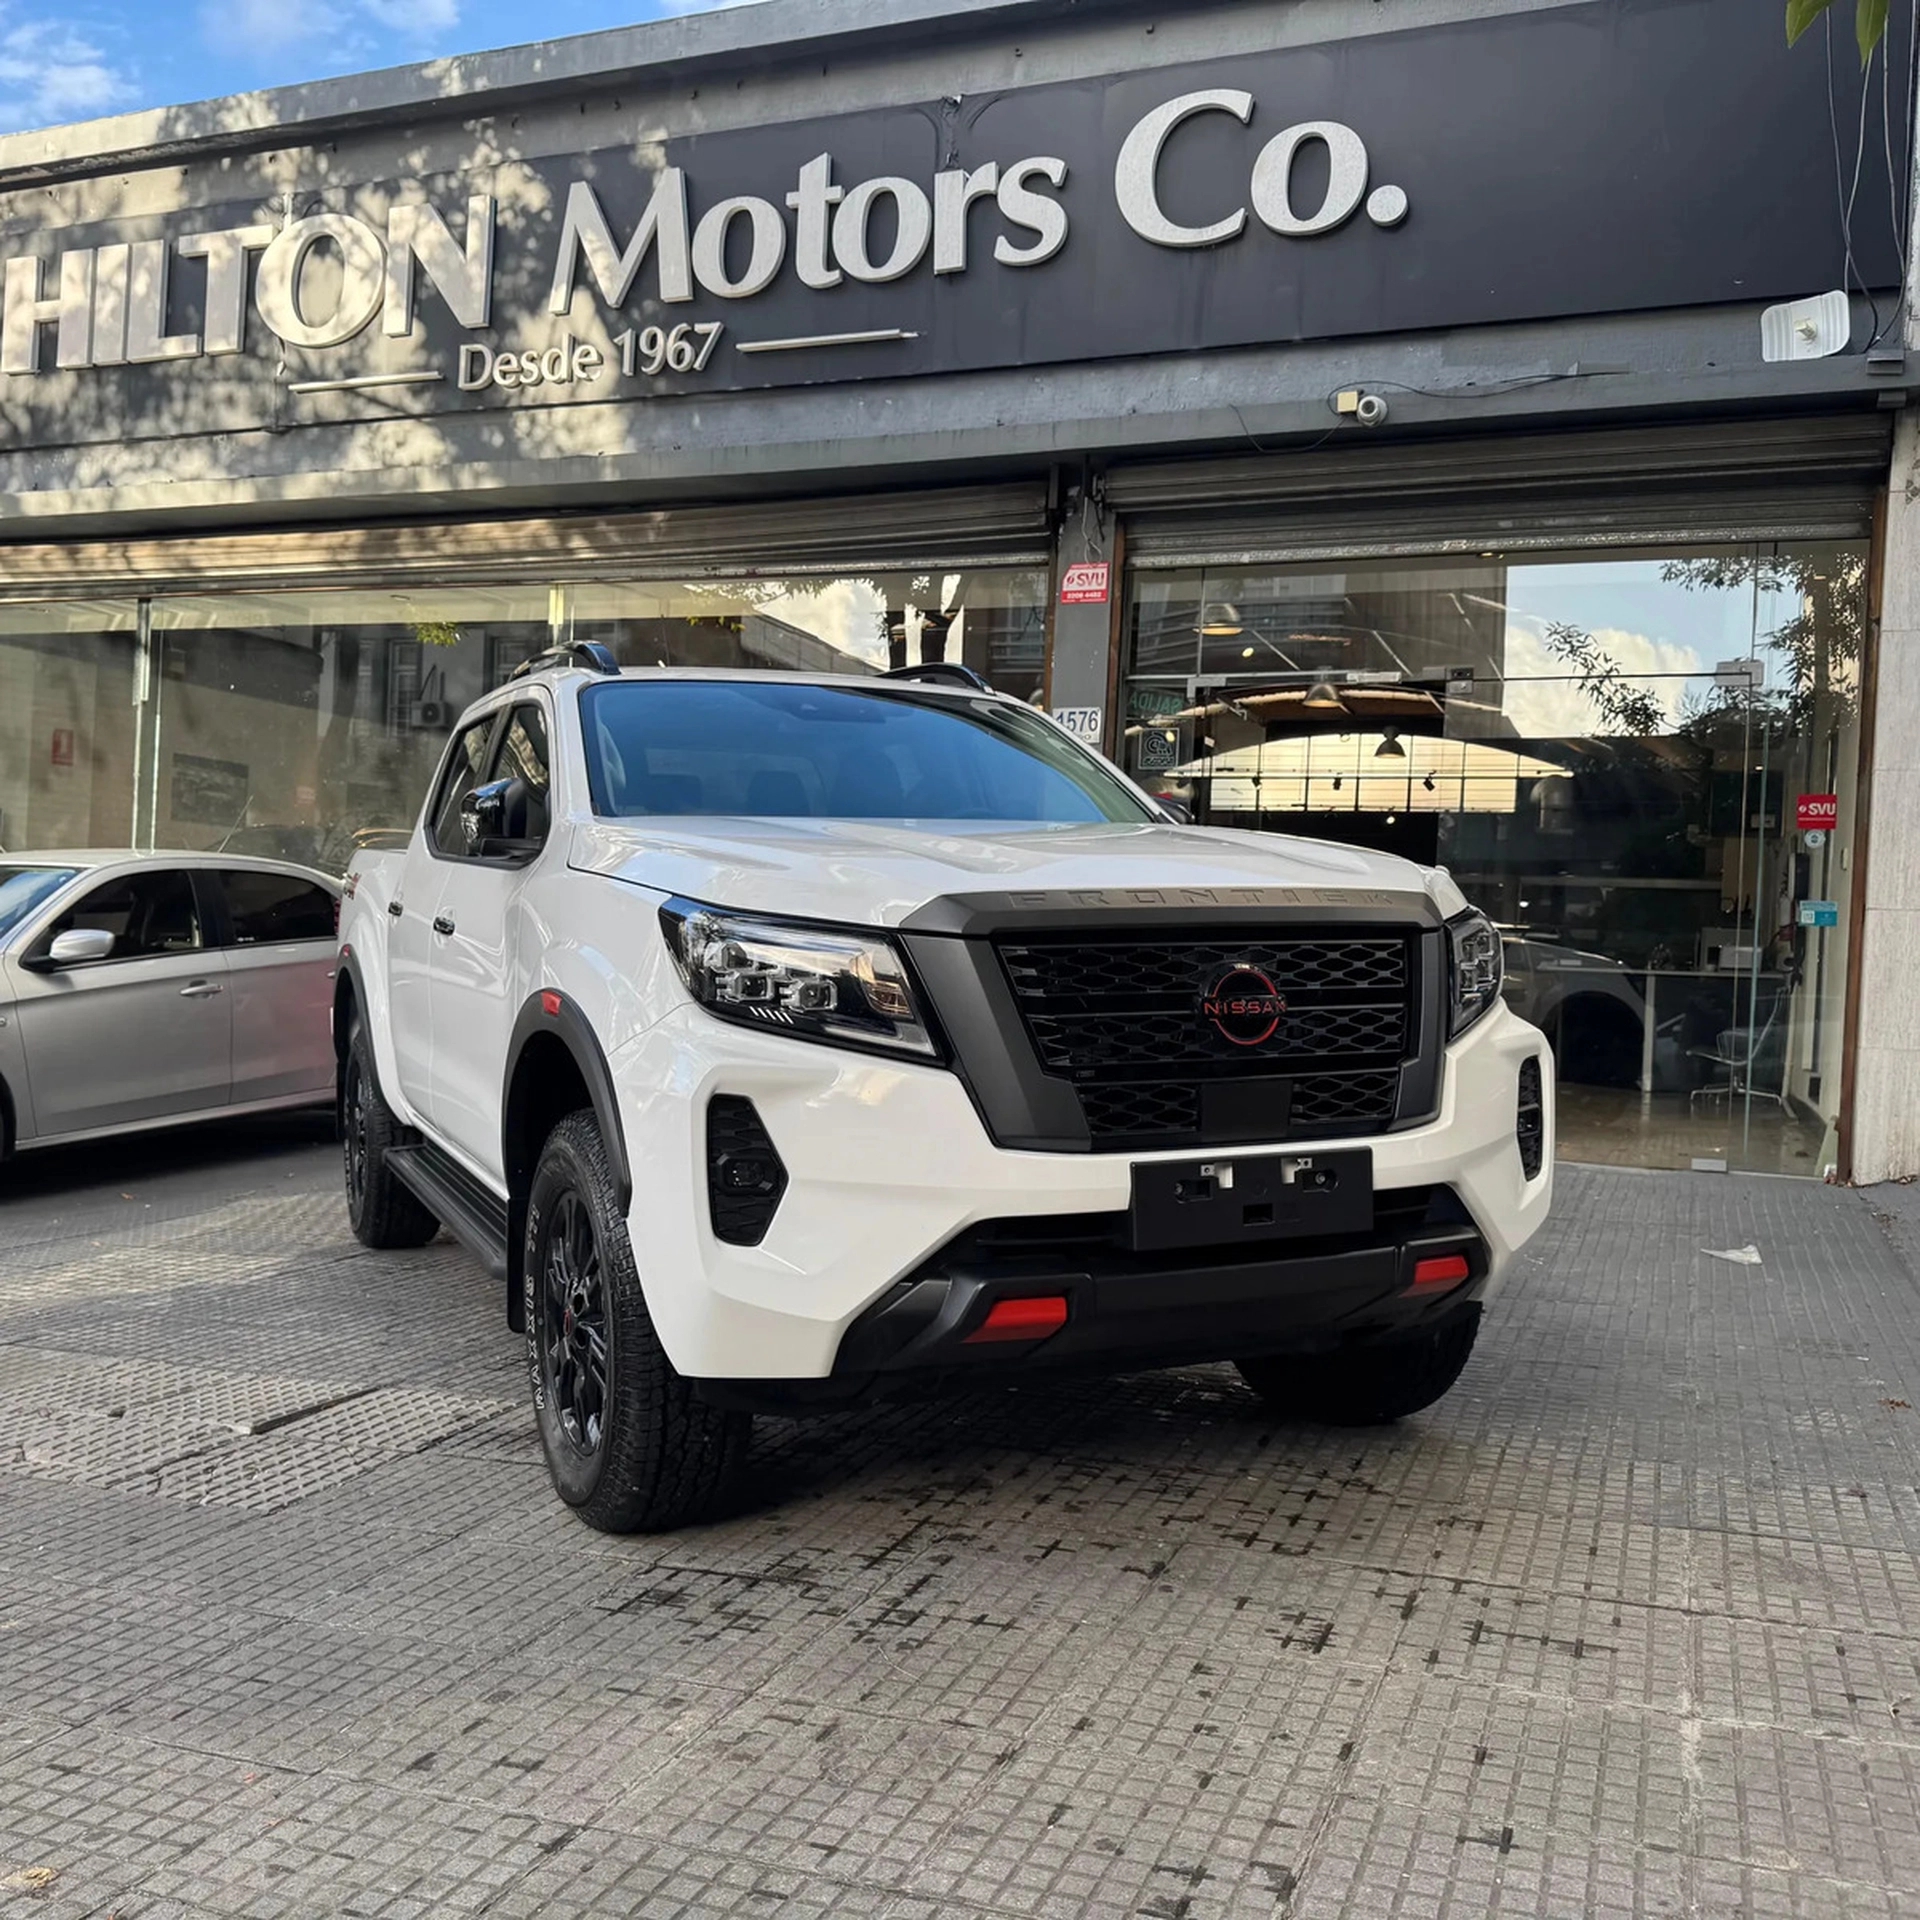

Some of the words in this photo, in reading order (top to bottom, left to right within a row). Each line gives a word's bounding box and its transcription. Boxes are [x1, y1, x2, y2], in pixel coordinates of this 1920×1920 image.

[2, 193, 499, 376] HILTON
[548, 152, 1068, 315] Motors
[1115, 88, 1409, 248] Co.
[458, 334, 602, 392] Desde
[613, 321, 725, 376] 1967
[1076, 572, 1105, 587] SVU
[1056, 710, 1099, 732] 1576
[1808, 803, 1836, 816] SVU
[1008, 889, 1394, 908] FRONTIER
[1204, 1001, 1287, 1015] NISSAN
